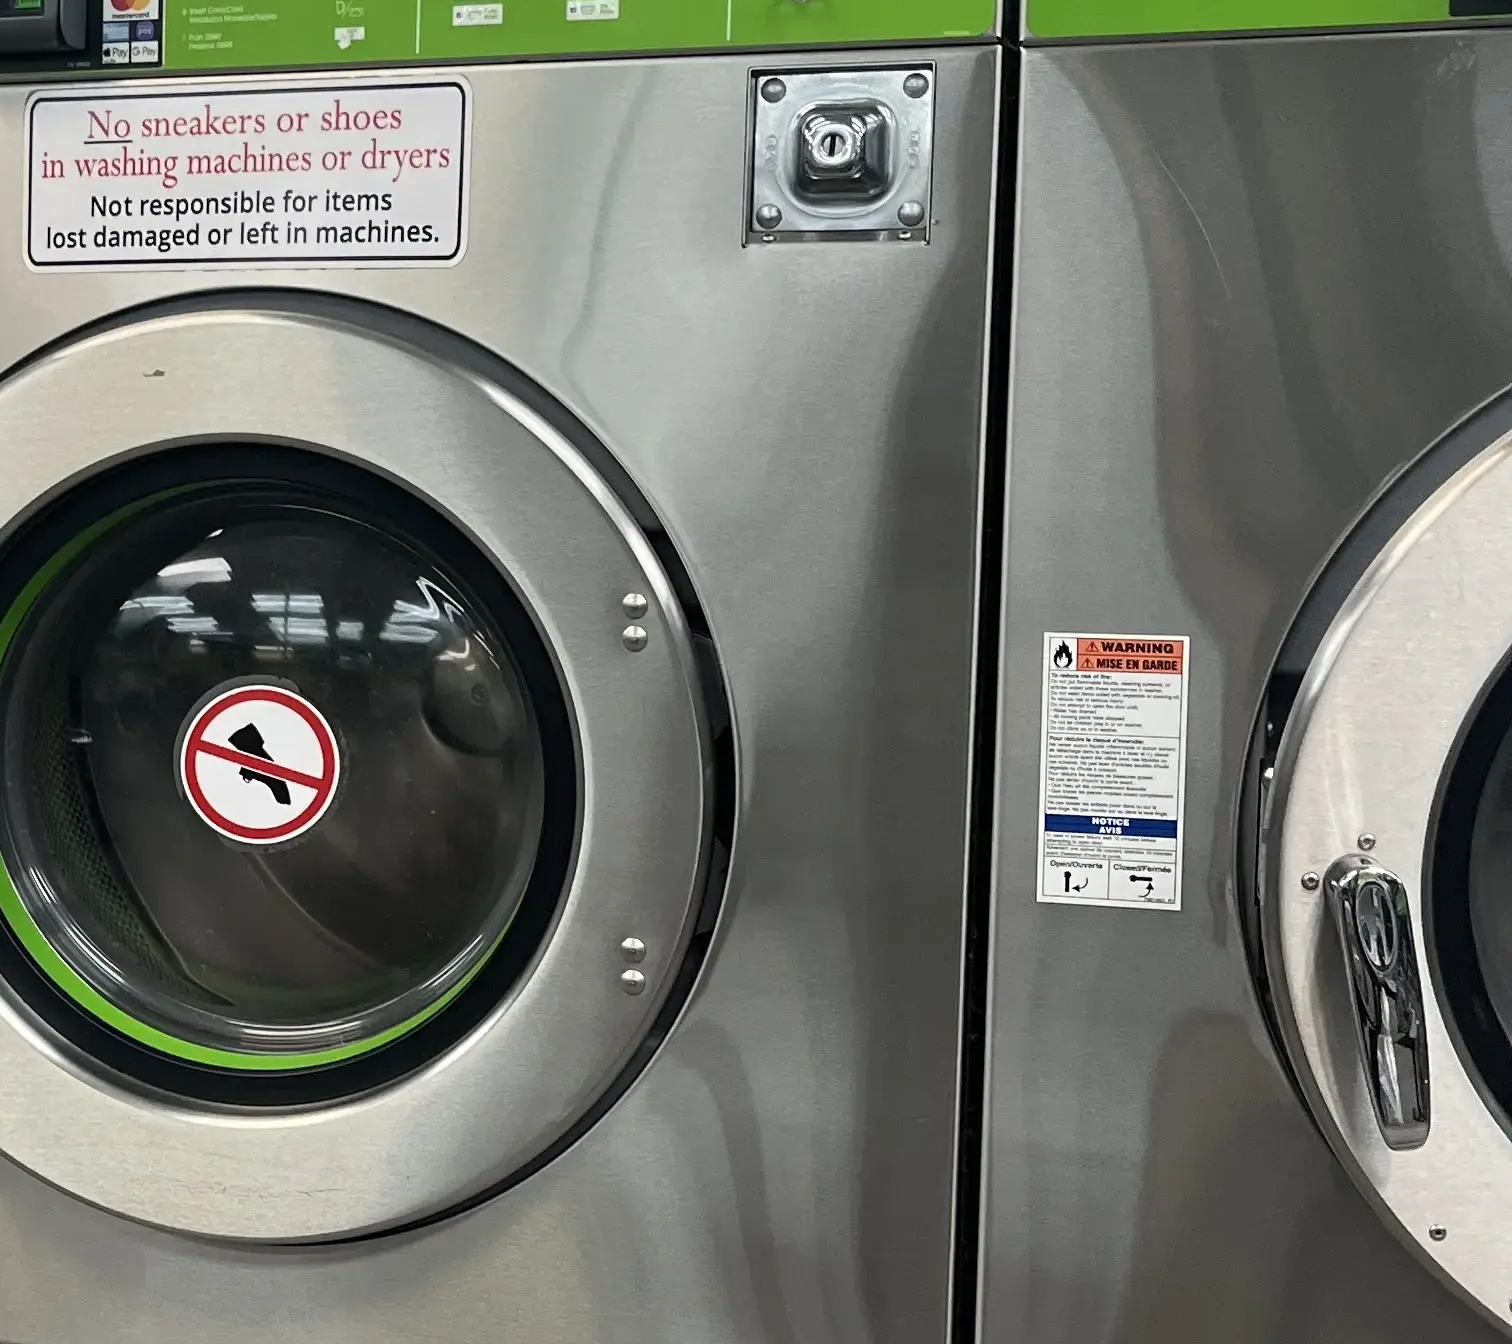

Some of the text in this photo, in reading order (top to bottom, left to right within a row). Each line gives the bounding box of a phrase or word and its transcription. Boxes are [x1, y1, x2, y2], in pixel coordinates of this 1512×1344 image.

[113, 47, 129, 59] Pay
[88, 100, 402, 141] No sneakers or shoes
[42, 138, 451, 189] in washing machines or dryers
[91, 189, 393, 221] Not responsible for items
[47, 219, 439, 253] lost damaged or left in machines.
[1101, 641, 1174, 654] WARNING
[1096, 658, 1178, 671] MISE EN GARDE
[1092, 817, 1130, 827] NOTICE
[1099, 827, 1122, 835] AVIS
